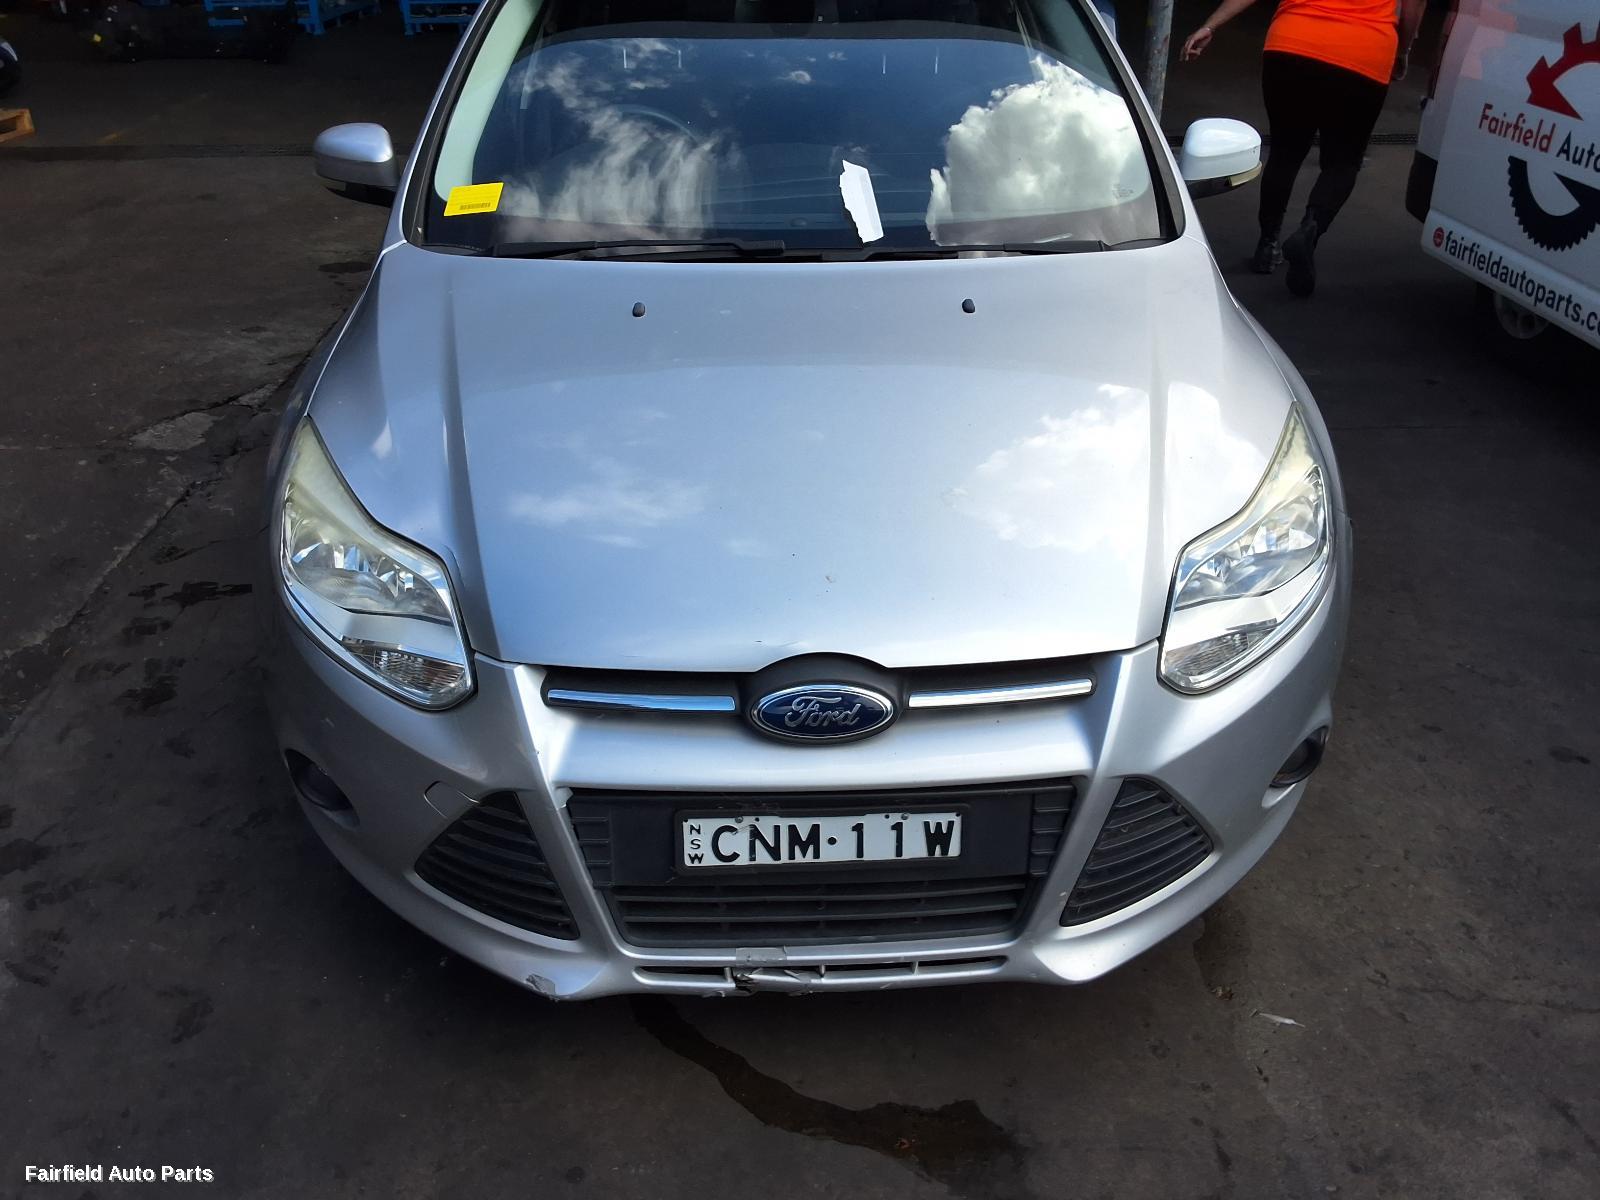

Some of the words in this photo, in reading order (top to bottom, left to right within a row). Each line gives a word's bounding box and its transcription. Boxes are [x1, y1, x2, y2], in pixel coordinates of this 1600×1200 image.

[1478, 103, 1556, 153] Fairfield
[1444, 230, 1600, 337] fairfieldautoparts.c
[784, 696, 862, 728] Ford
